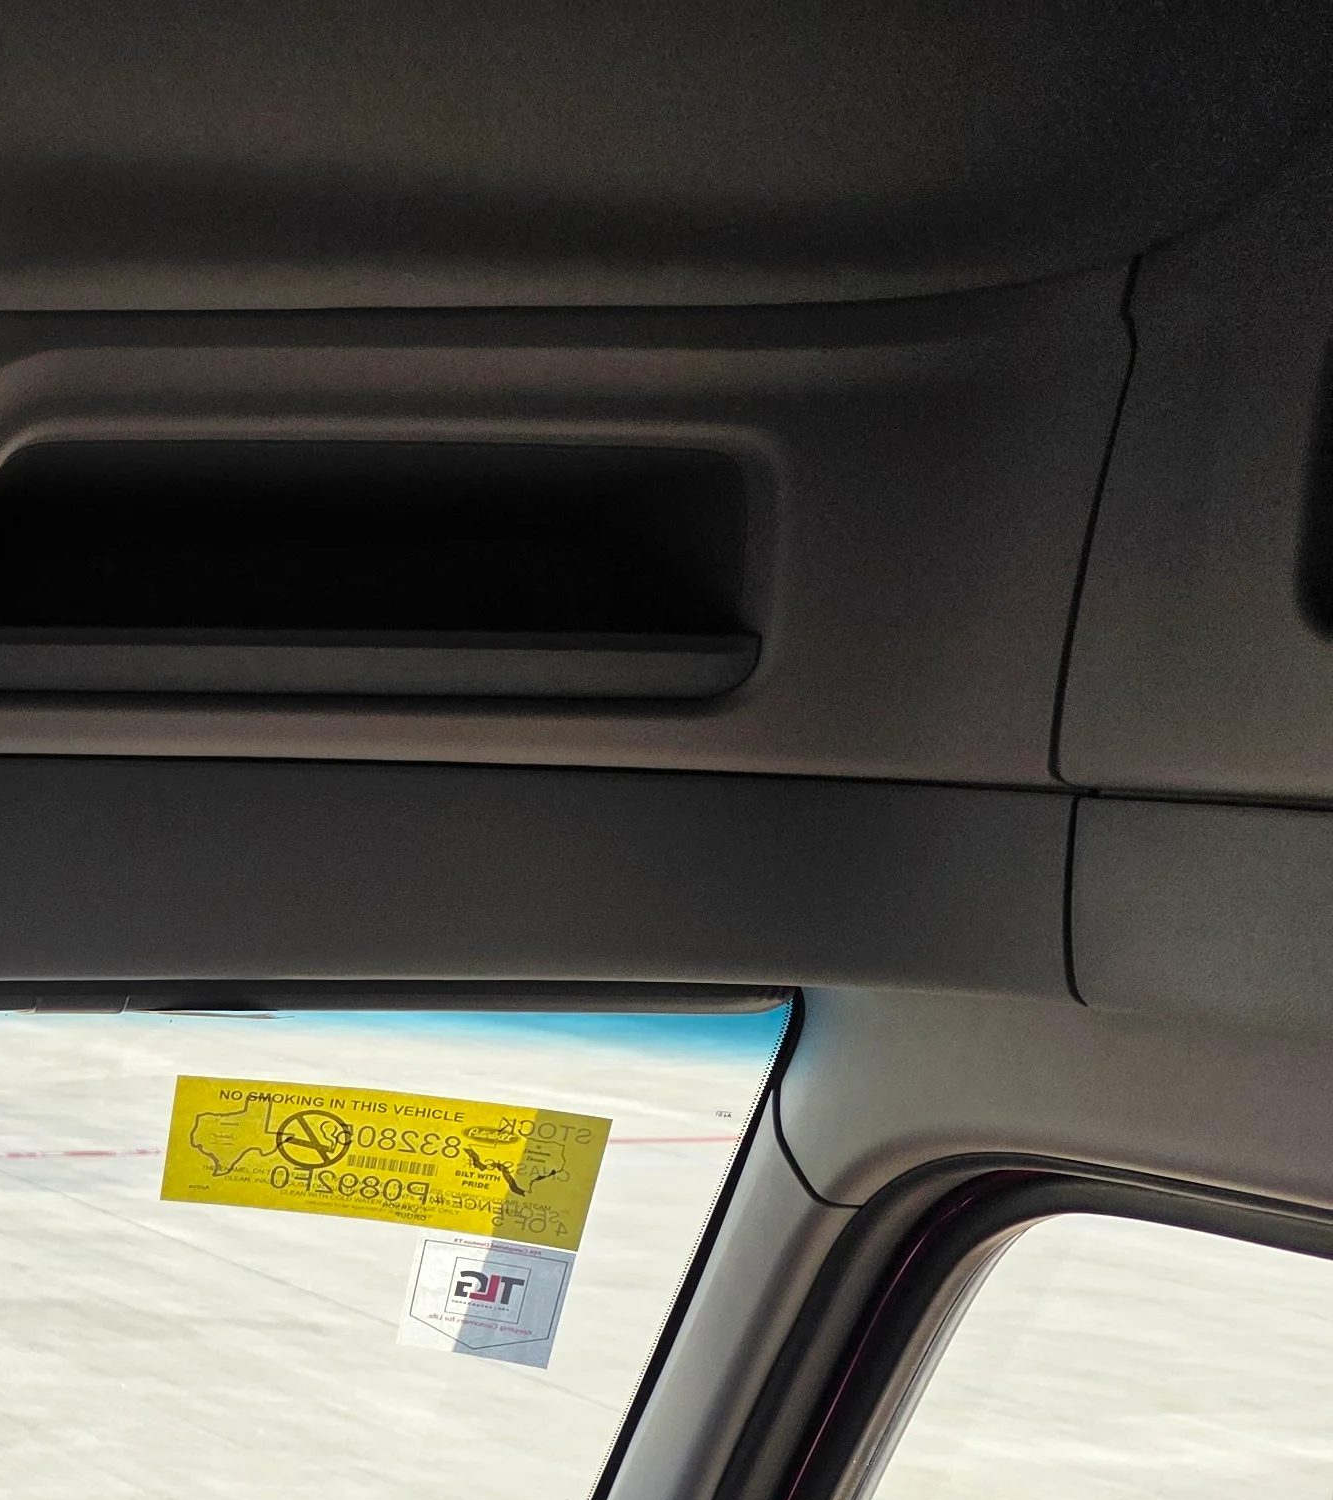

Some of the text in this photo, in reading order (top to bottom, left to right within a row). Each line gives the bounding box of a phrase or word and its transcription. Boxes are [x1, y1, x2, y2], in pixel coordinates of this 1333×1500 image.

[219, 1089, 466, 1123] NO SMOKING IN THIS VEHICLE
[454, 1169, 502, 1183] BILT WITH
[461, 1180, 490, 1190] PRIDE
